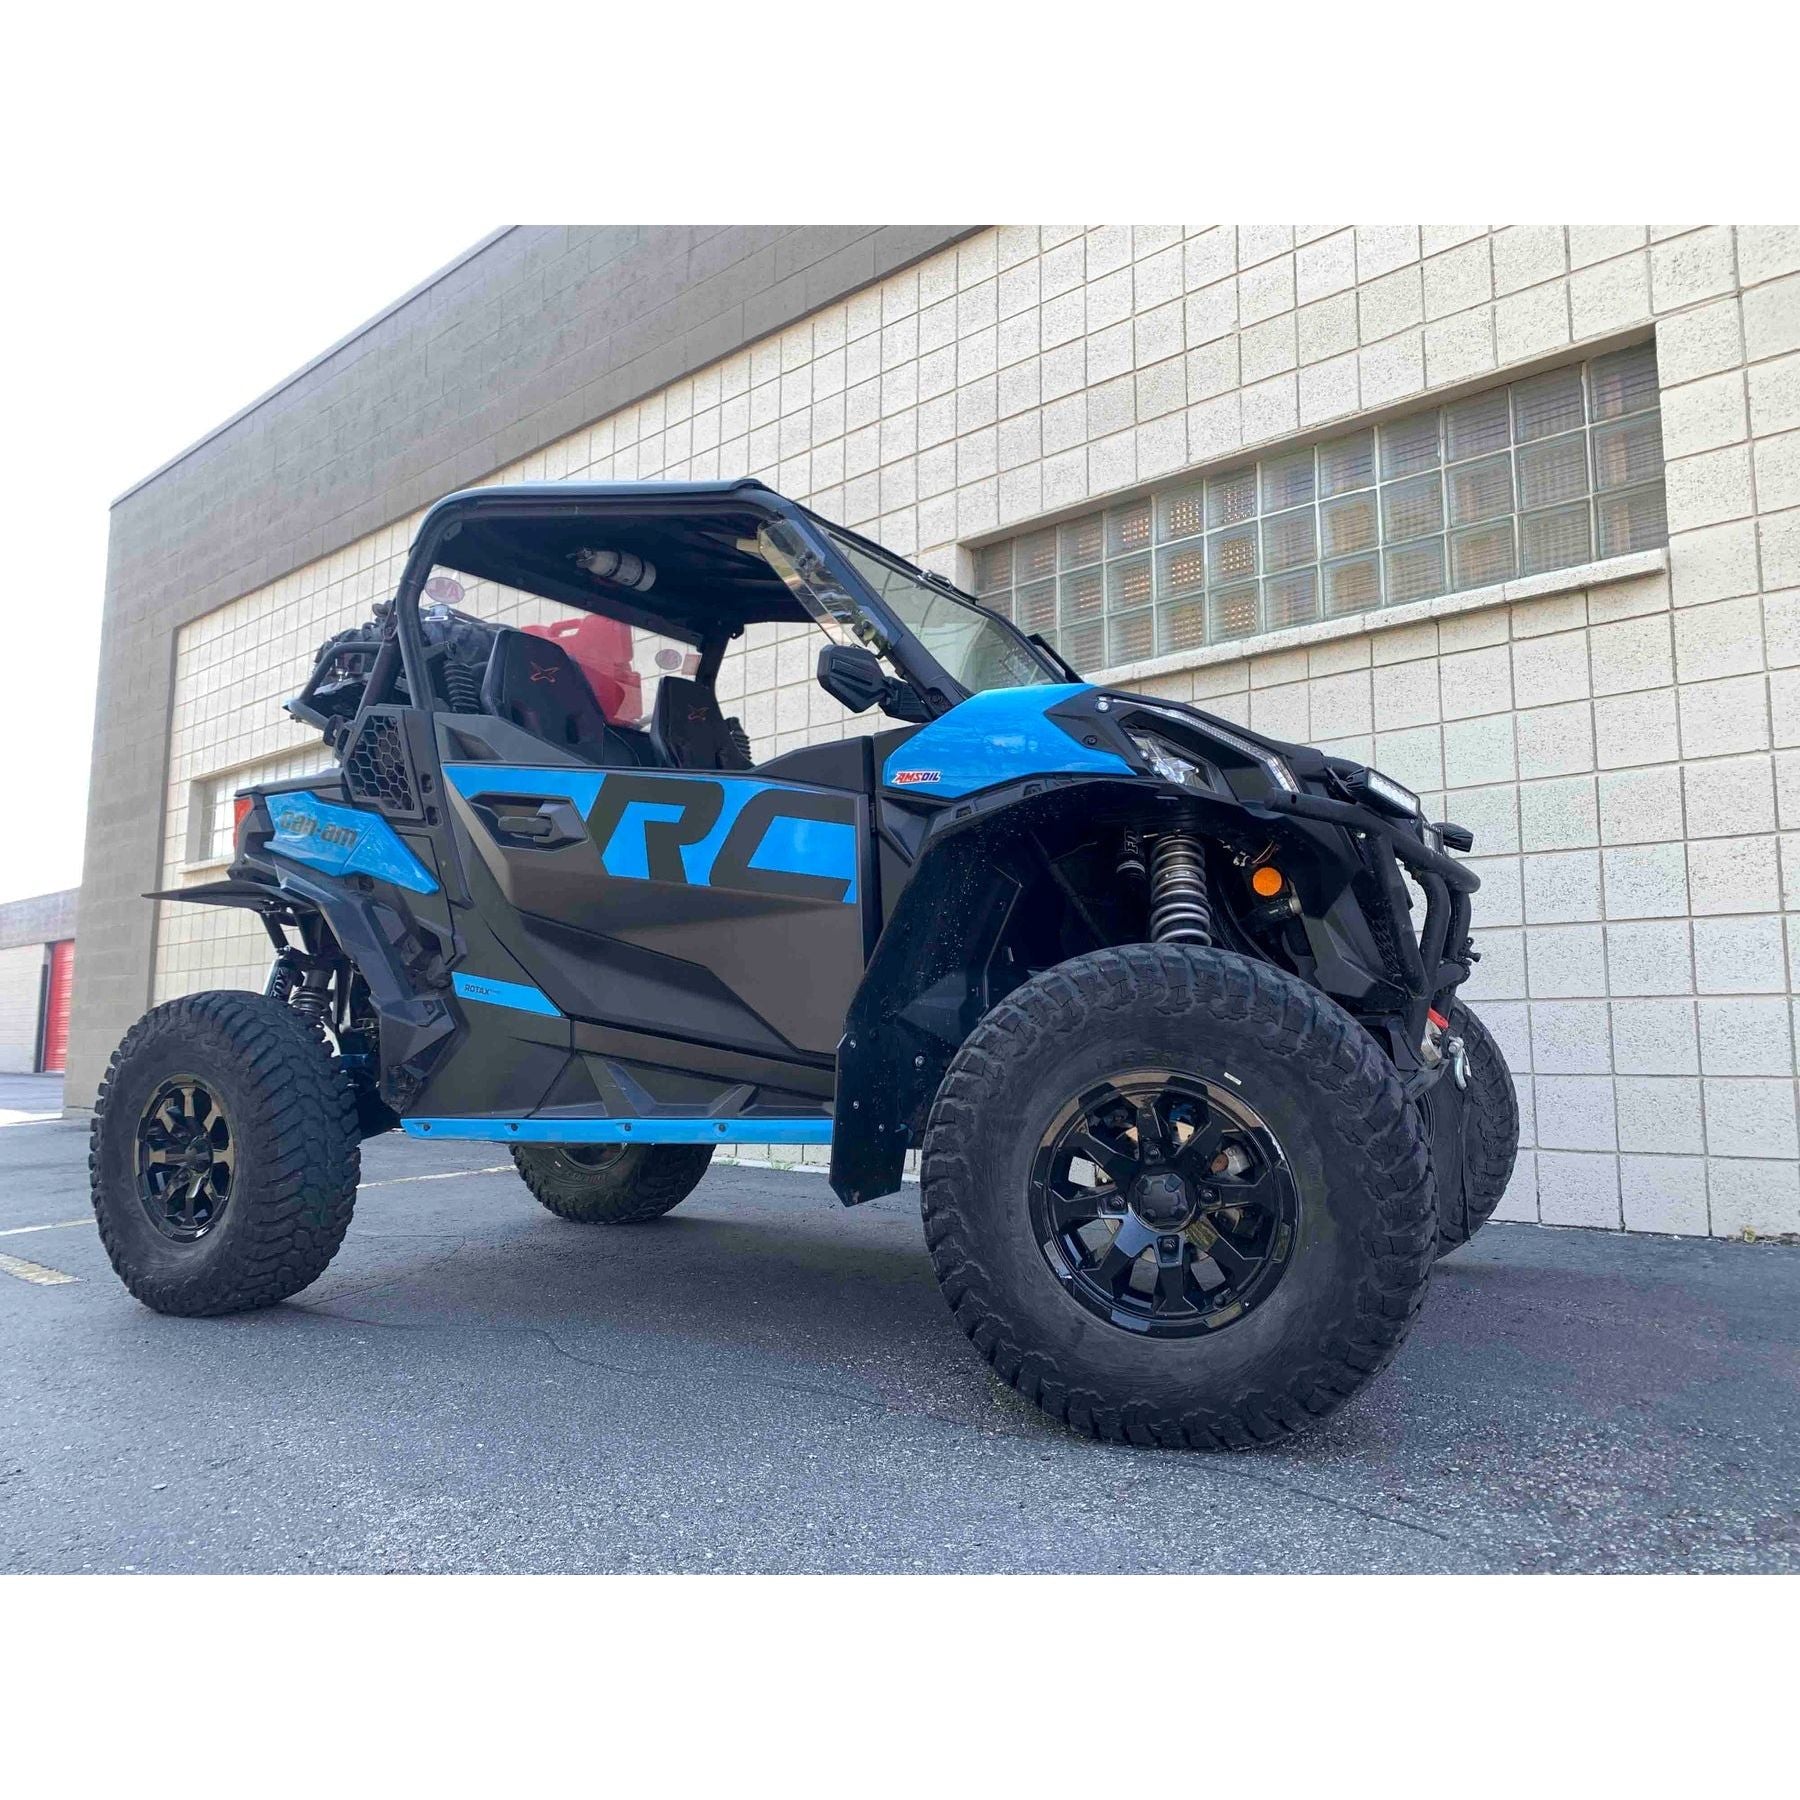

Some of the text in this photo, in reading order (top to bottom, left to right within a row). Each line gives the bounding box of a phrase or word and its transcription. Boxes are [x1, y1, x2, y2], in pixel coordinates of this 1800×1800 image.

[895, 772, 940, 783] AMSOIL
[280, 811, 358, 848] can-am
[464, 983, 490, 995] ROTAX
